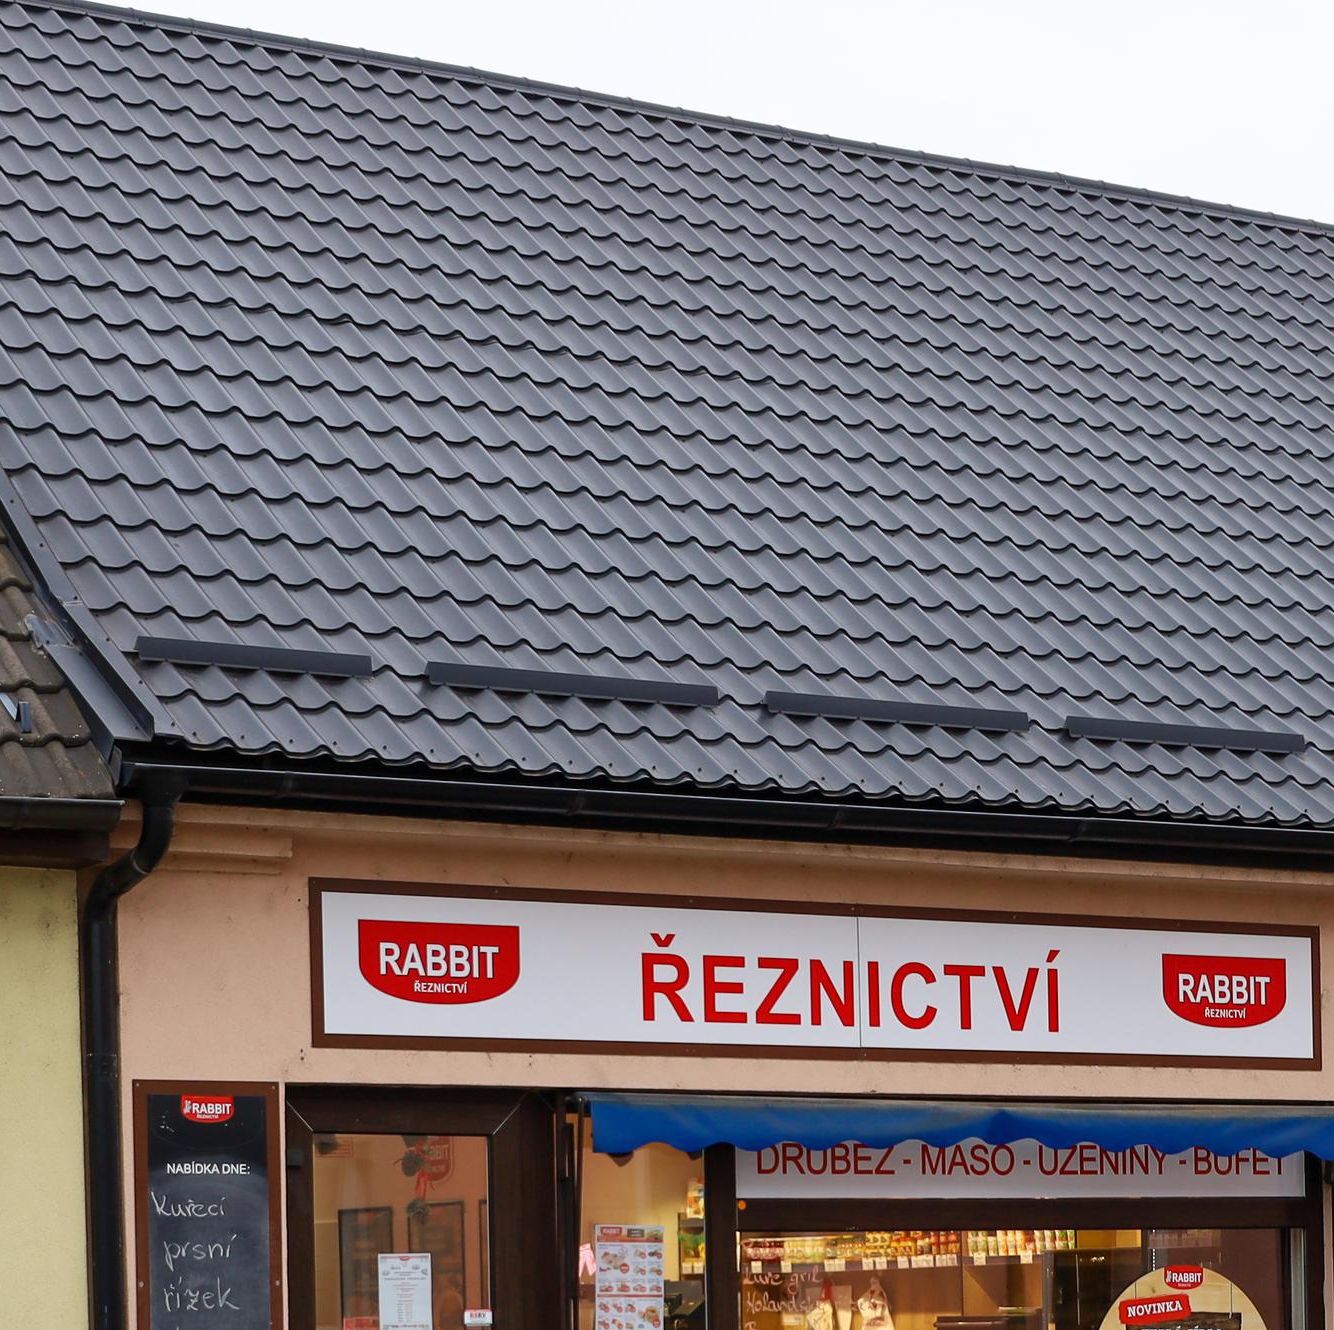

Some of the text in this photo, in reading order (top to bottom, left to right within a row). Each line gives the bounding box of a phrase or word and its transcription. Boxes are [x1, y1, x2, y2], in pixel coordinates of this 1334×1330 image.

[379, 941, 500, 979] RABBIT
[414, 979, 468, 994] ŘEZNICTVÍ
[642, 934, 1060, 1032] ŘEZNICTVÍ
[1178, 973, 1271, 1005] RABBIT
[1204, 1006, 1247, 1019] ŘEZNICTVÍ
[192, 1103, 232, 1115] RABBIT
[166, 1160, 251, 1175] NABÍDKA DNE:
[920, 1143, 1016, 1176] MASO
[1038, 1144, 1167, 1175] UZENINY
[164, 1234, 237, 1272] prsní
[1172, 1272, 1202, 1283] RABBIT
[1127, 1300, 1183, 1318] NOVINKA
